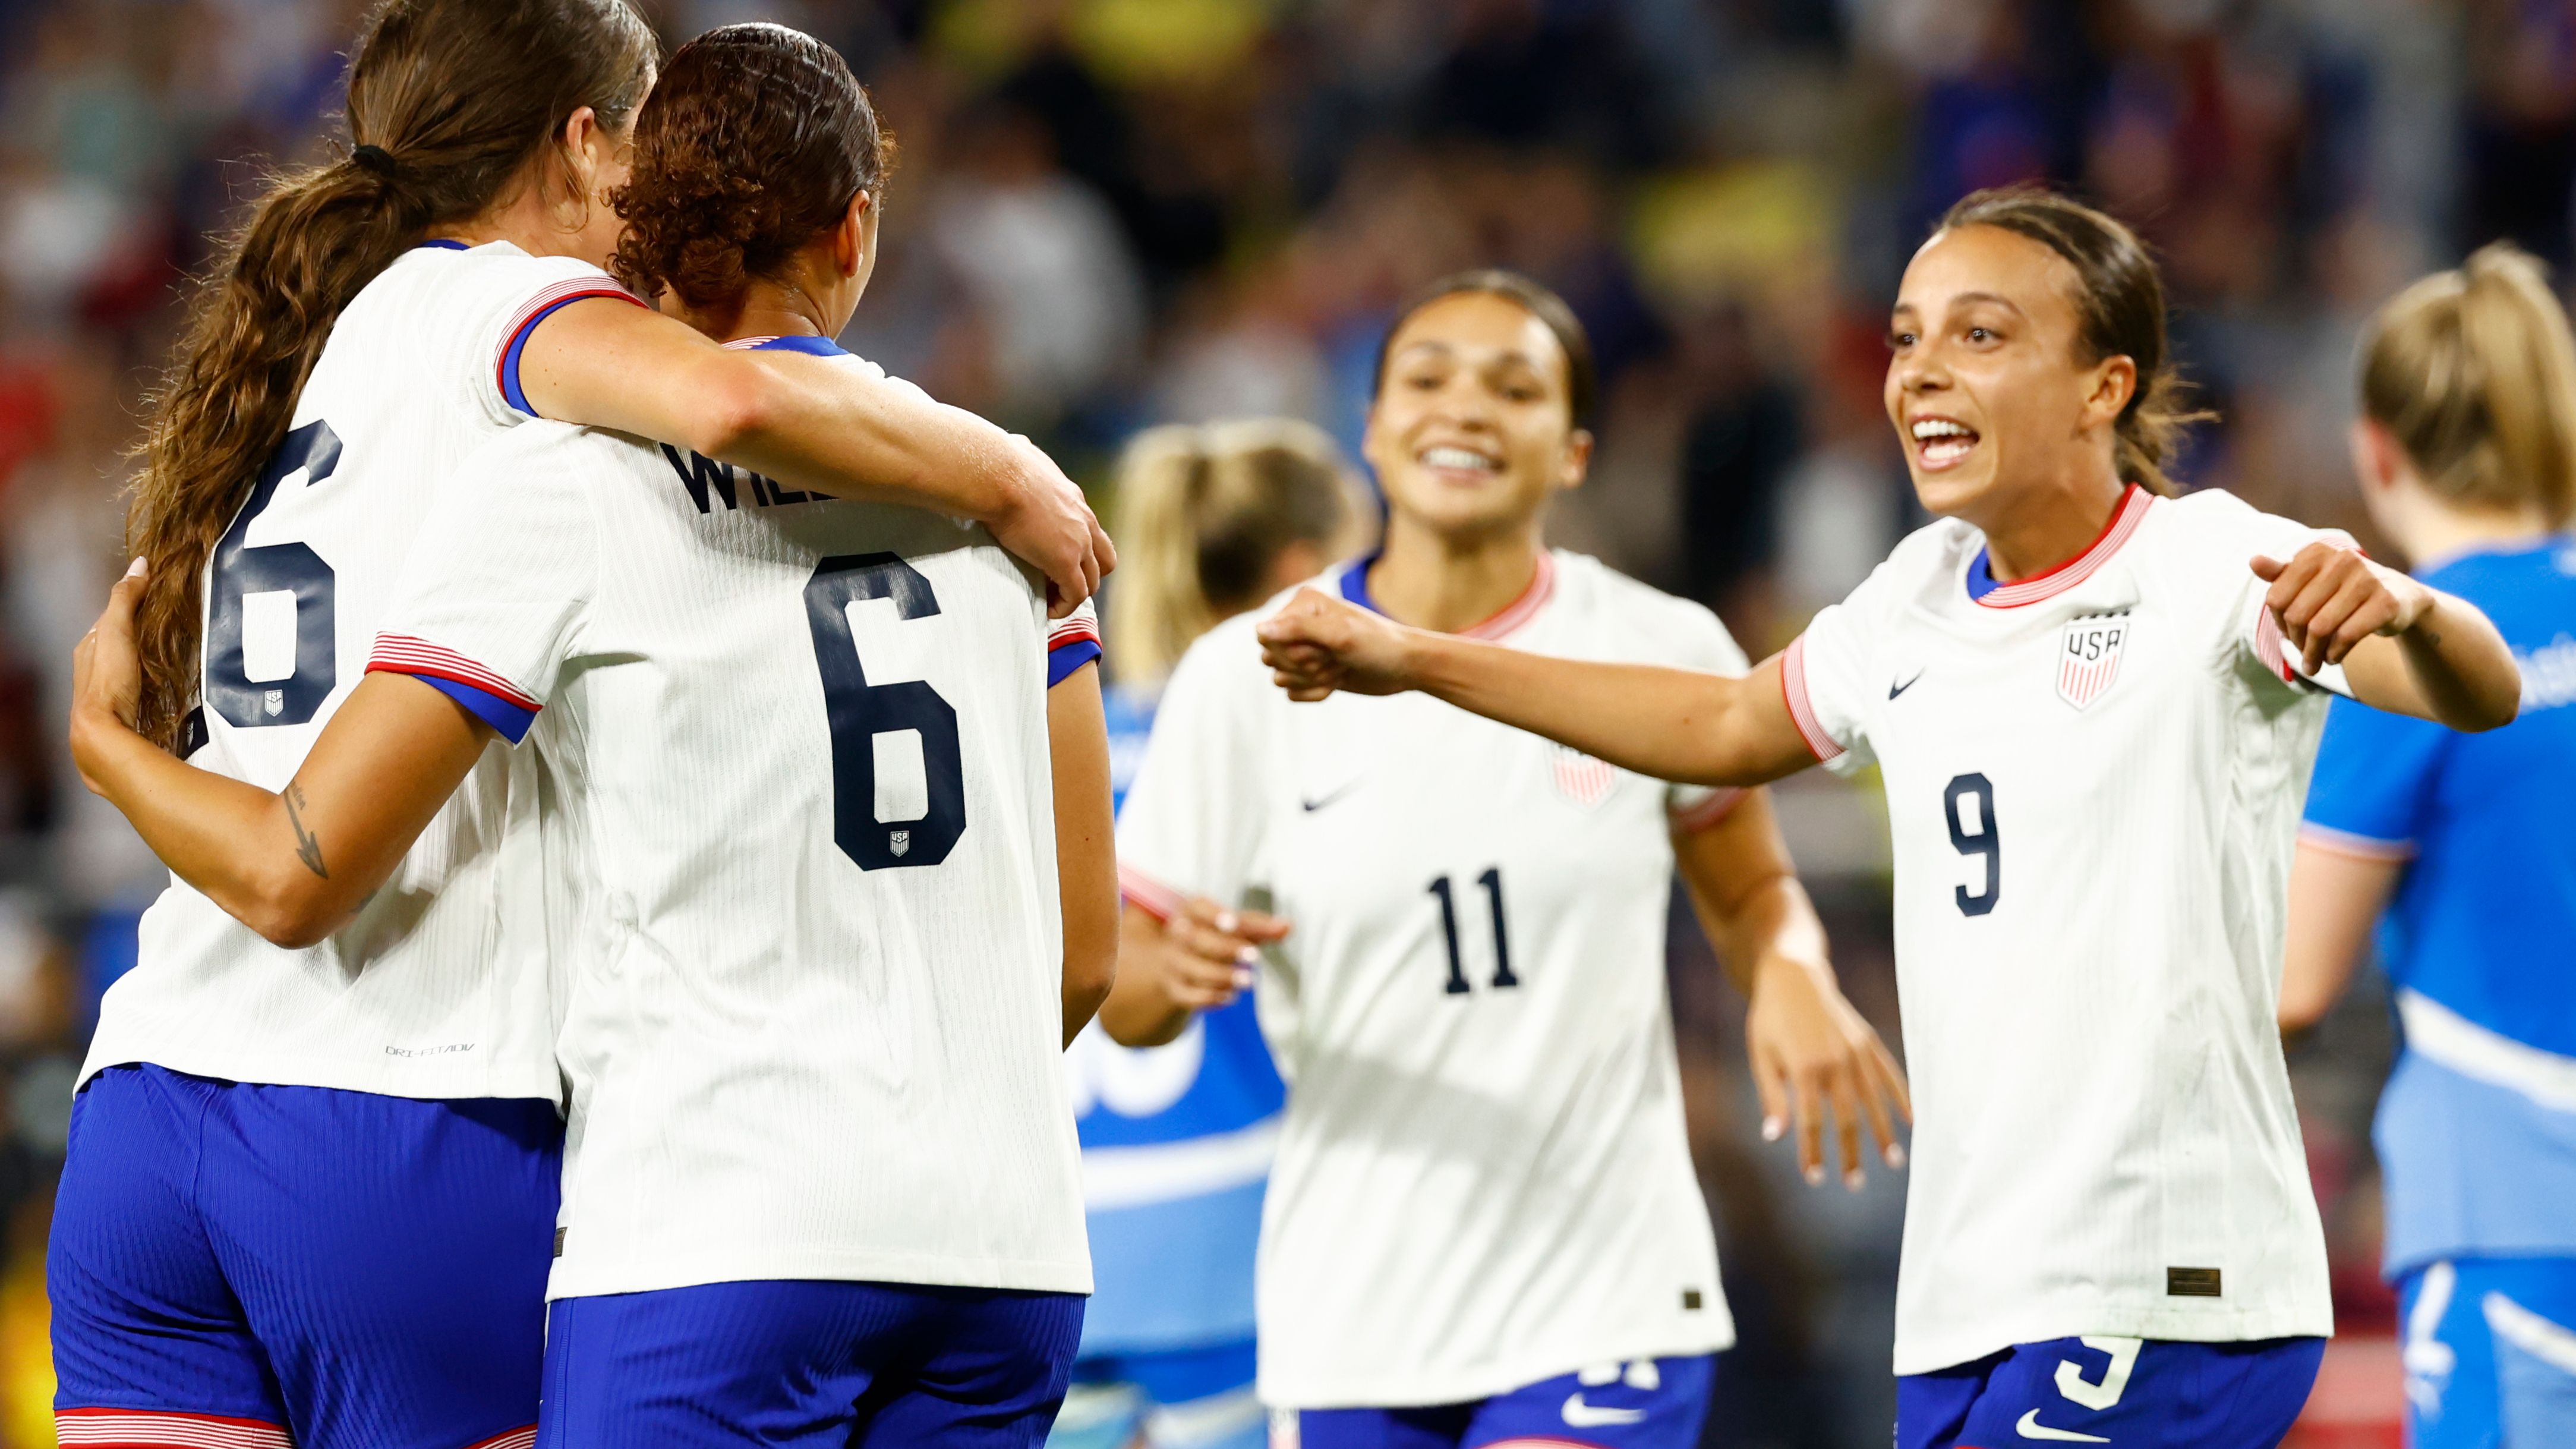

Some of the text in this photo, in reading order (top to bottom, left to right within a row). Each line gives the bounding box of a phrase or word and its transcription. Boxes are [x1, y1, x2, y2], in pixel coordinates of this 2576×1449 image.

[2069, 629, 2121, 661] USA
[267, 691, 281, 703] USA
[802, 551, 966, 871] 6
[892, 833, 907, 842] USA
[1944, 773, 2000, 916] 9
[1428, 867, 1519, 994] 11
